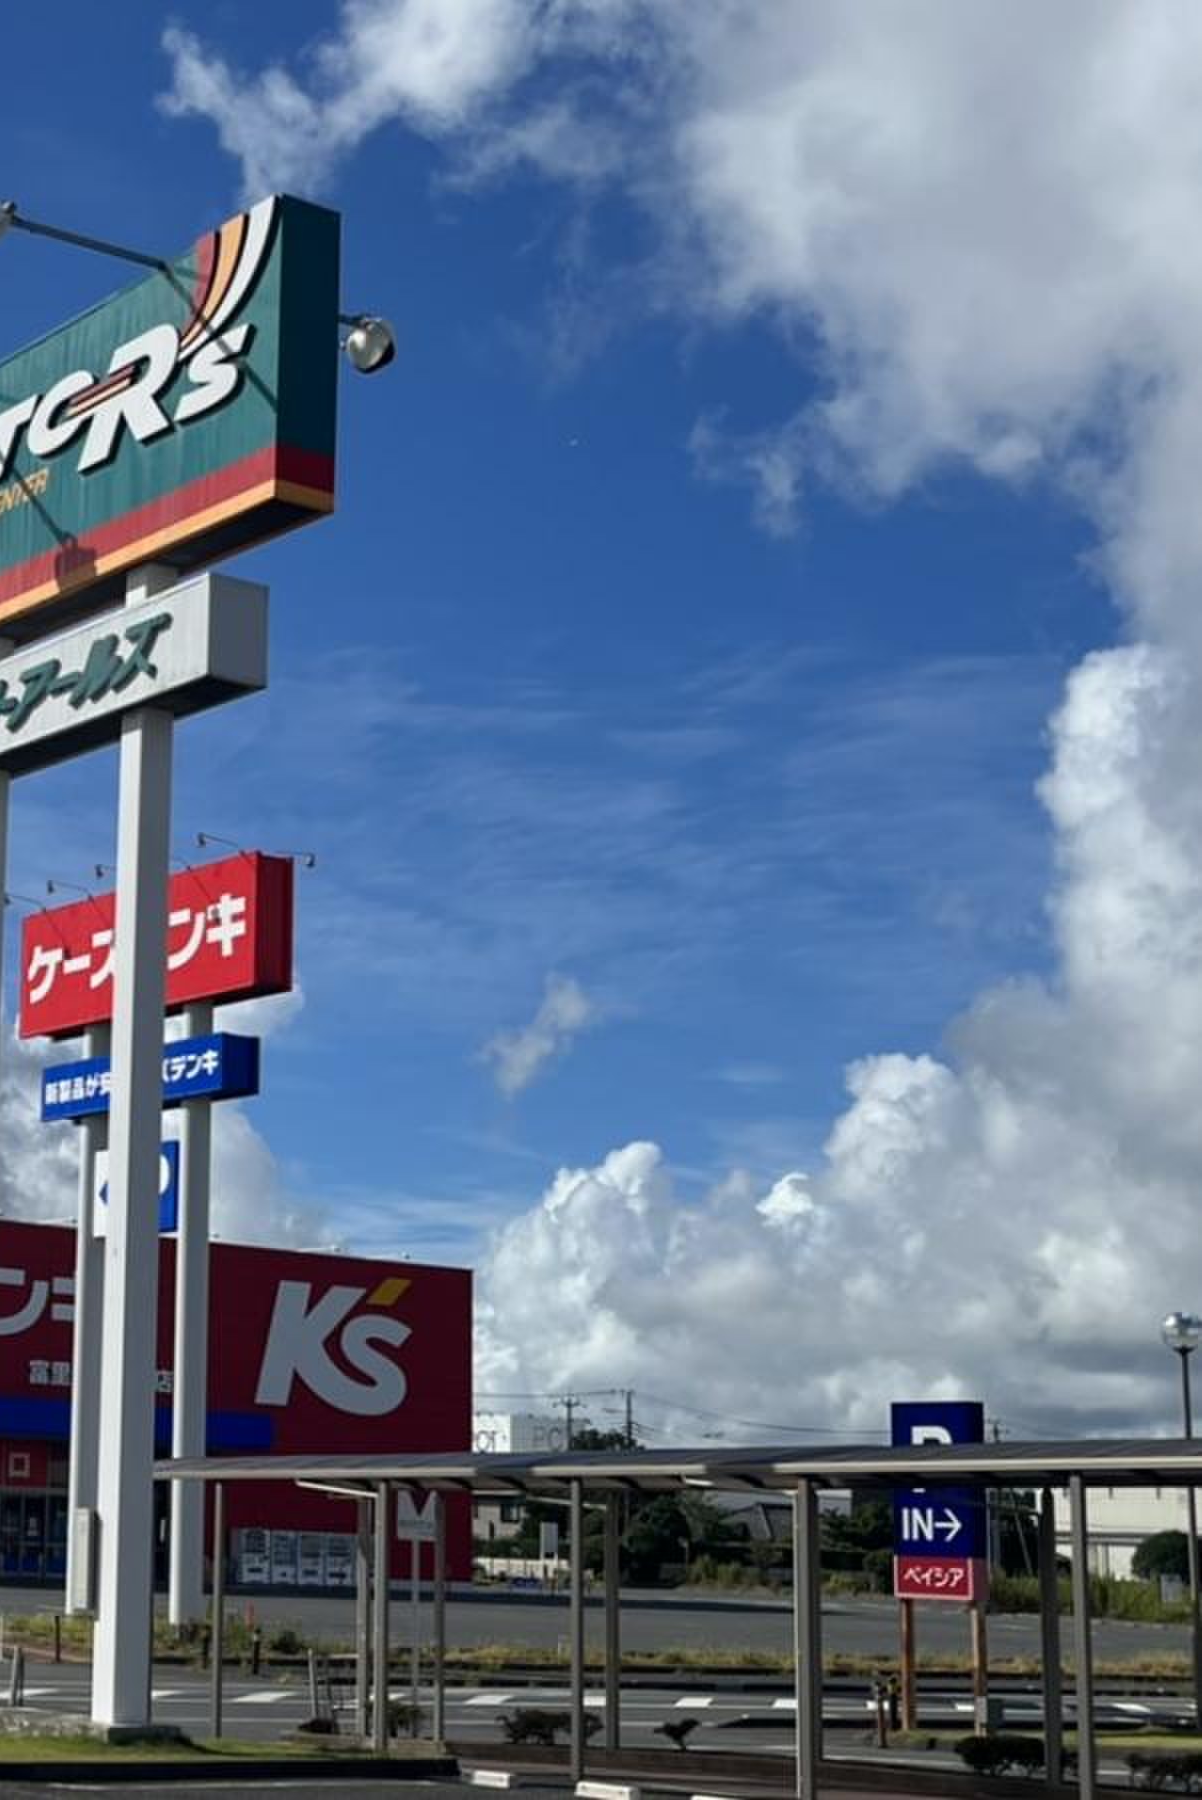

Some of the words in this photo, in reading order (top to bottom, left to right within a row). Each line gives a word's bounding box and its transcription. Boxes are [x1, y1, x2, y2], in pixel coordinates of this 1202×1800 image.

[901, 1507, 934, 1541] IN
[904, 1565, 965, 1589] ベイシア
